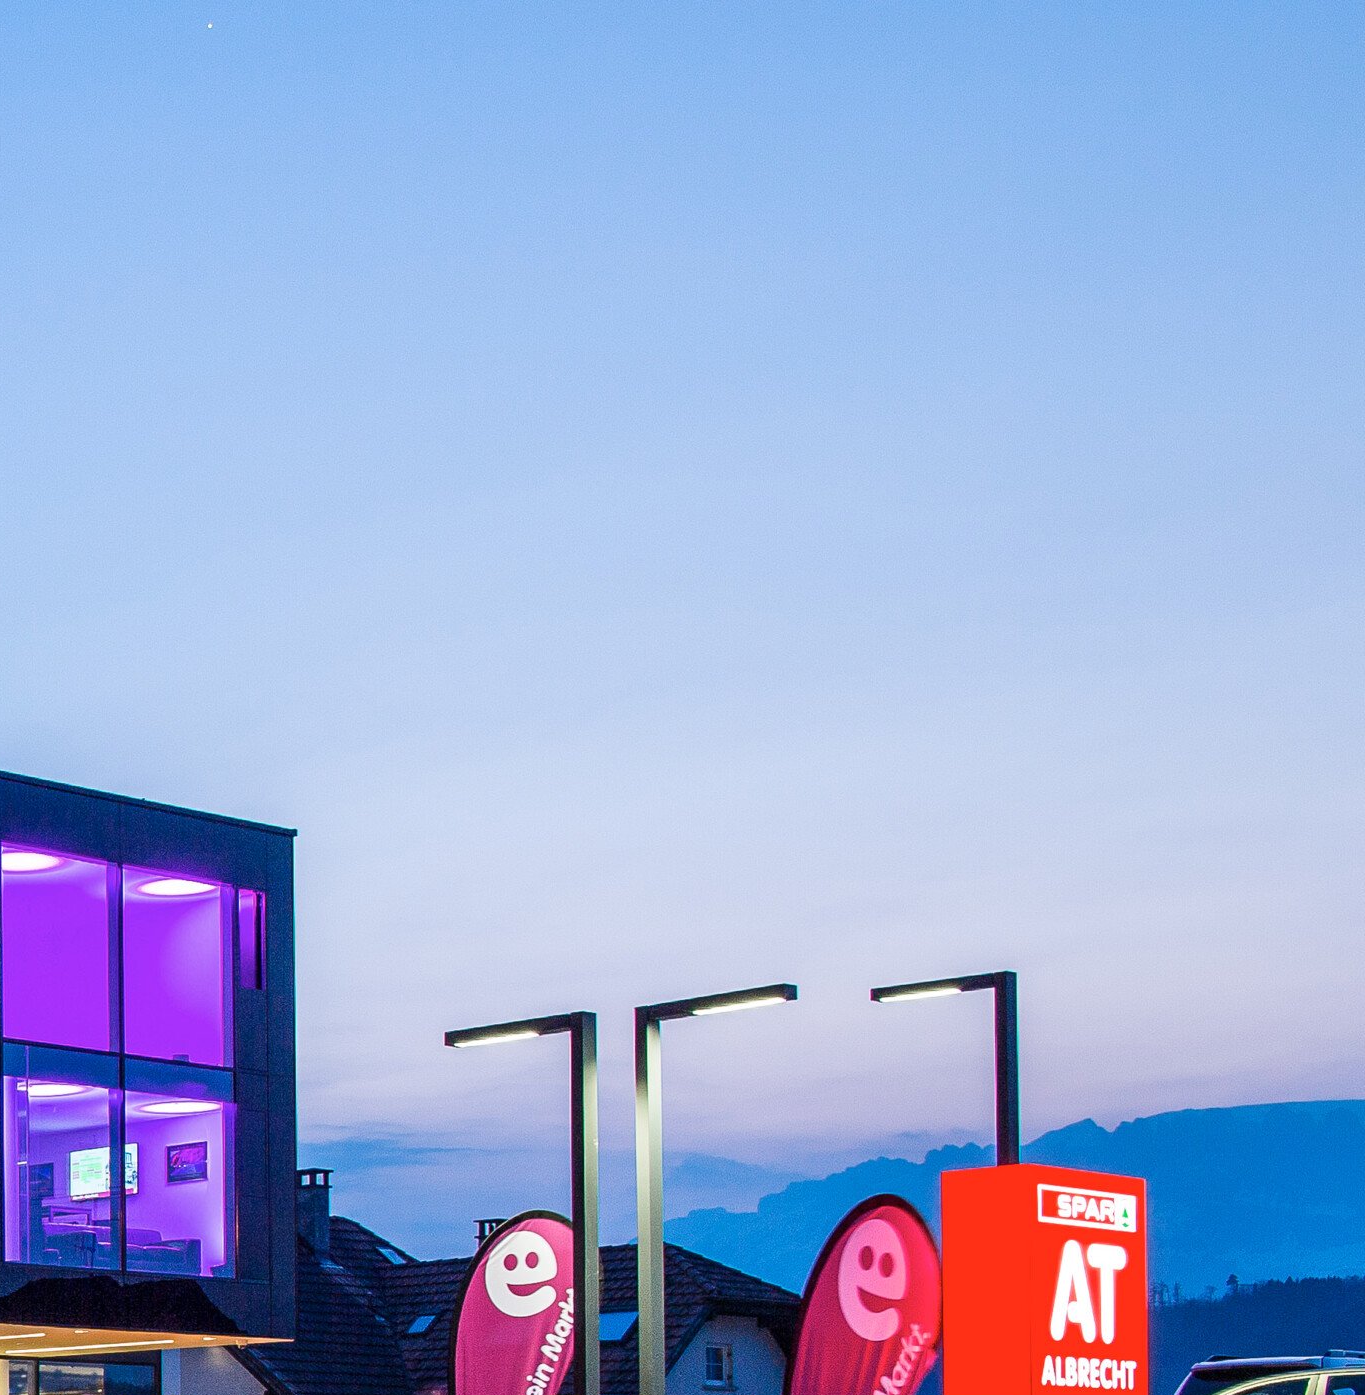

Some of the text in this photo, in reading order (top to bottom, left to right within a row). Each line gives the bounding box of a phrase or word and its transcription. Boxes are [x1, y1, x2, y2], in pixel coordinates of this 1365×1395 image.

[1057, 1194, 1116, 1223] SPAR
[1050, 1239, 1127, 1345] AT
[1041, 1354, 1137, 1390] ALBRECHT
